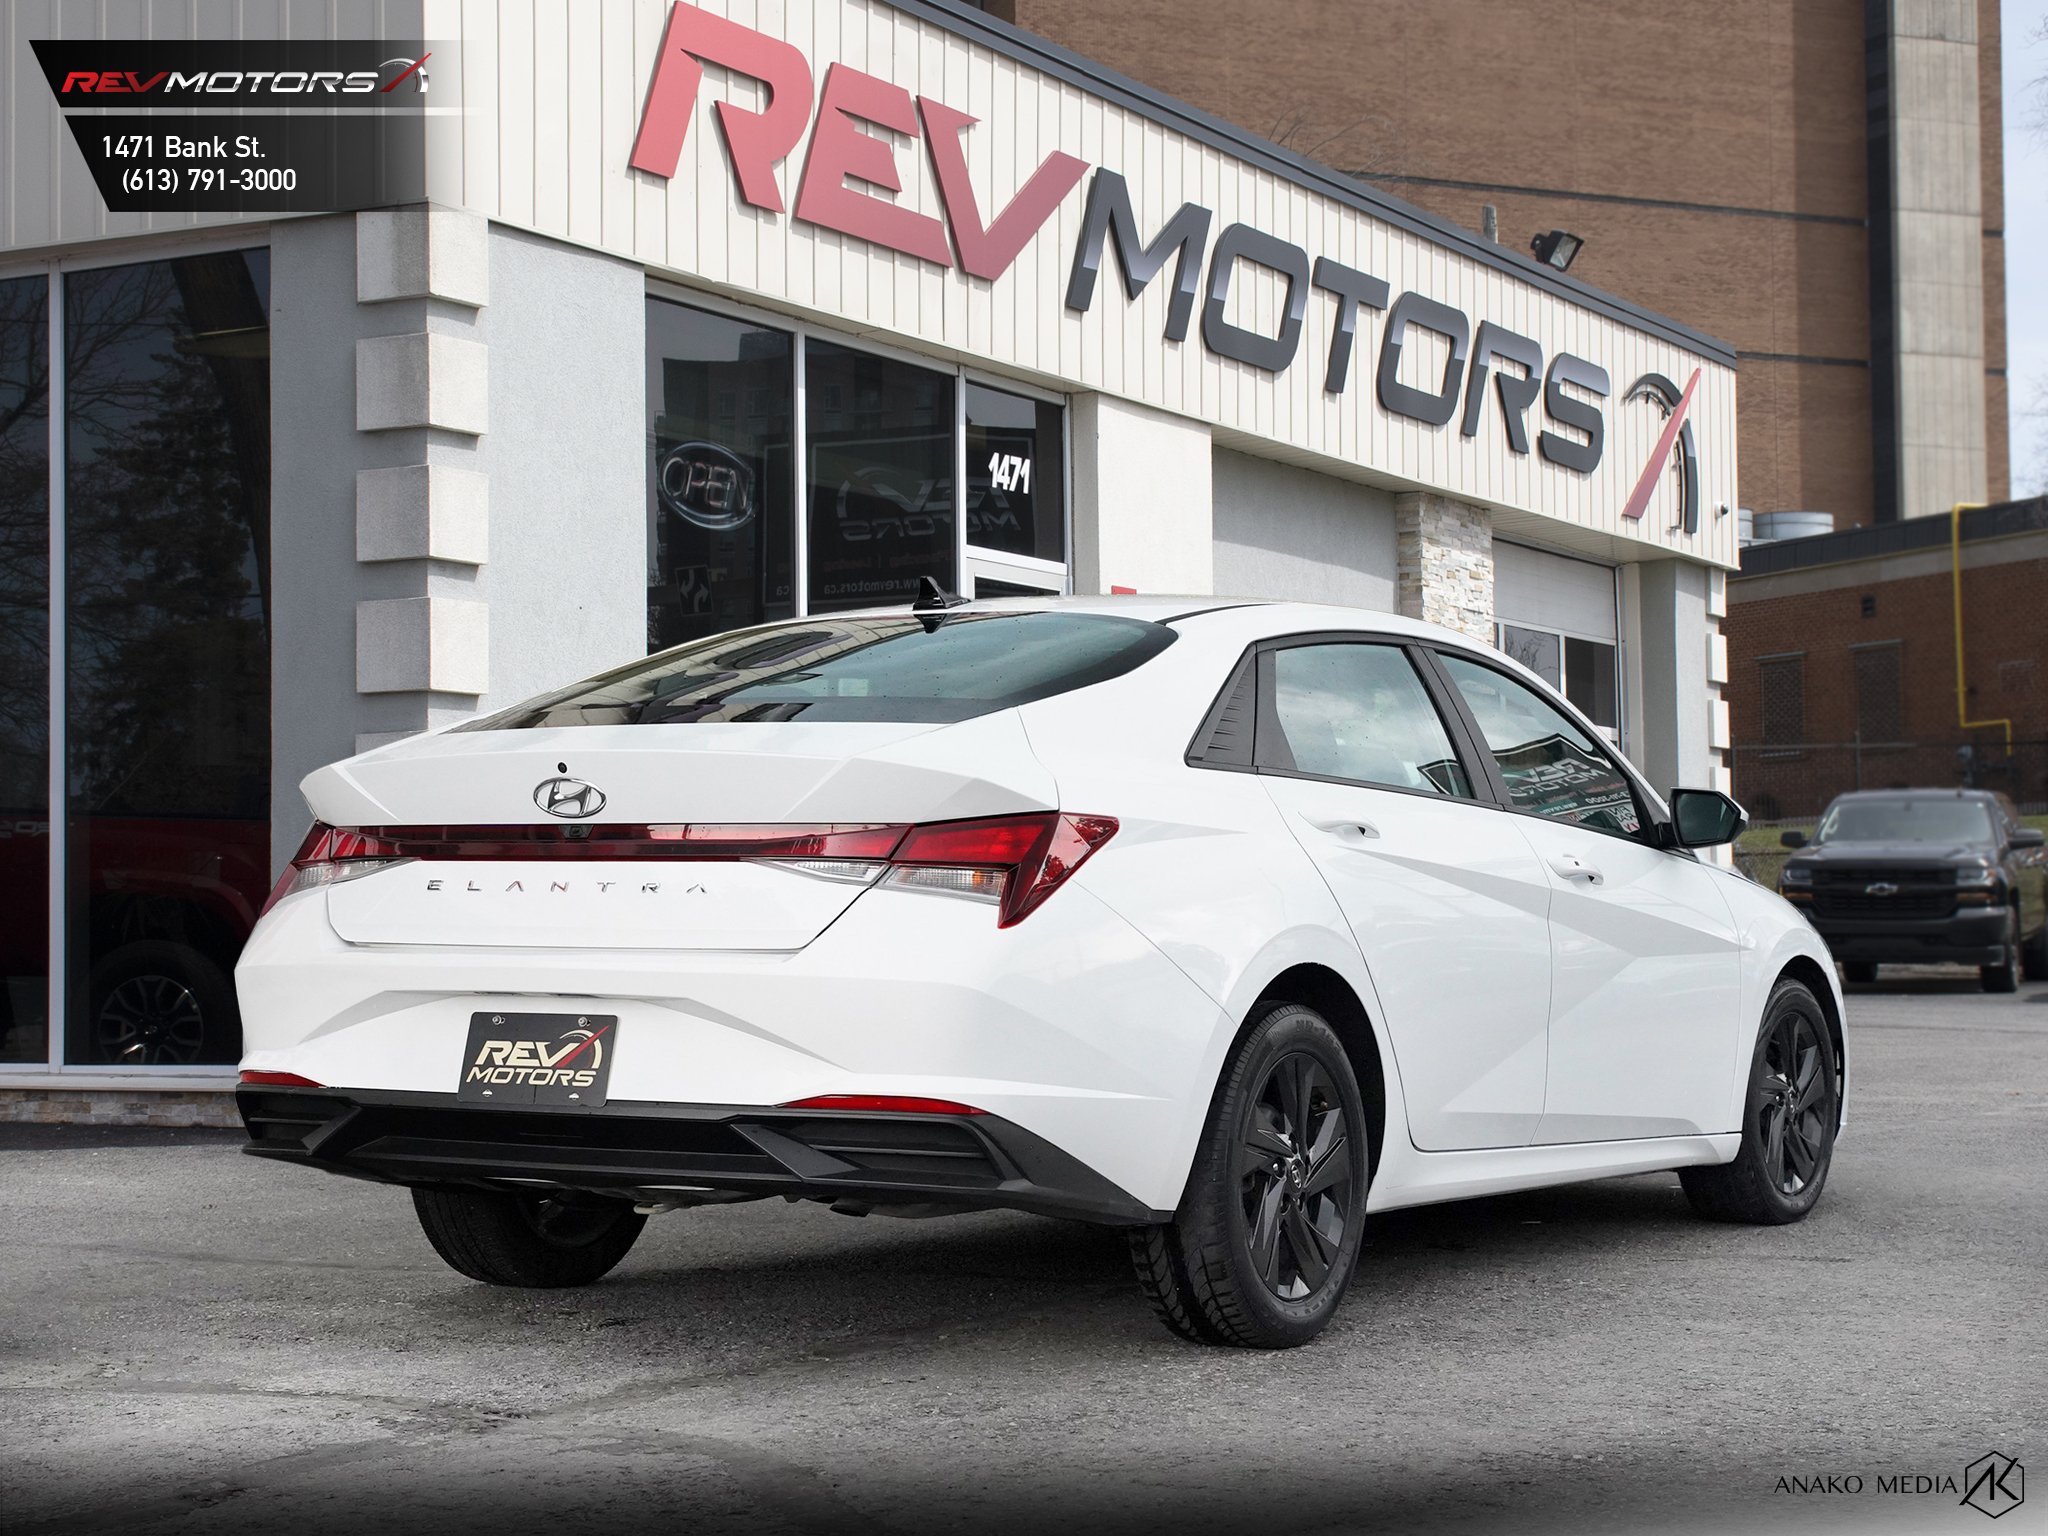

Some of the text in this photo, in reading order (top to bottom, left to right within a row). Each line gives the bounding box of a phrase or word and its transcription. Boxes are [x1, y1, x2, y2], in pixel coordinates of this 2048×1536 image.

[663, 457, 754, 511] OPEN
[988, 452, 1030, 494] 1471
[427, 879, 708, 894] ELANTRA
[474, 1040, 581, 1067] REV
[465, 1066, 597, 1087] MOTORS
